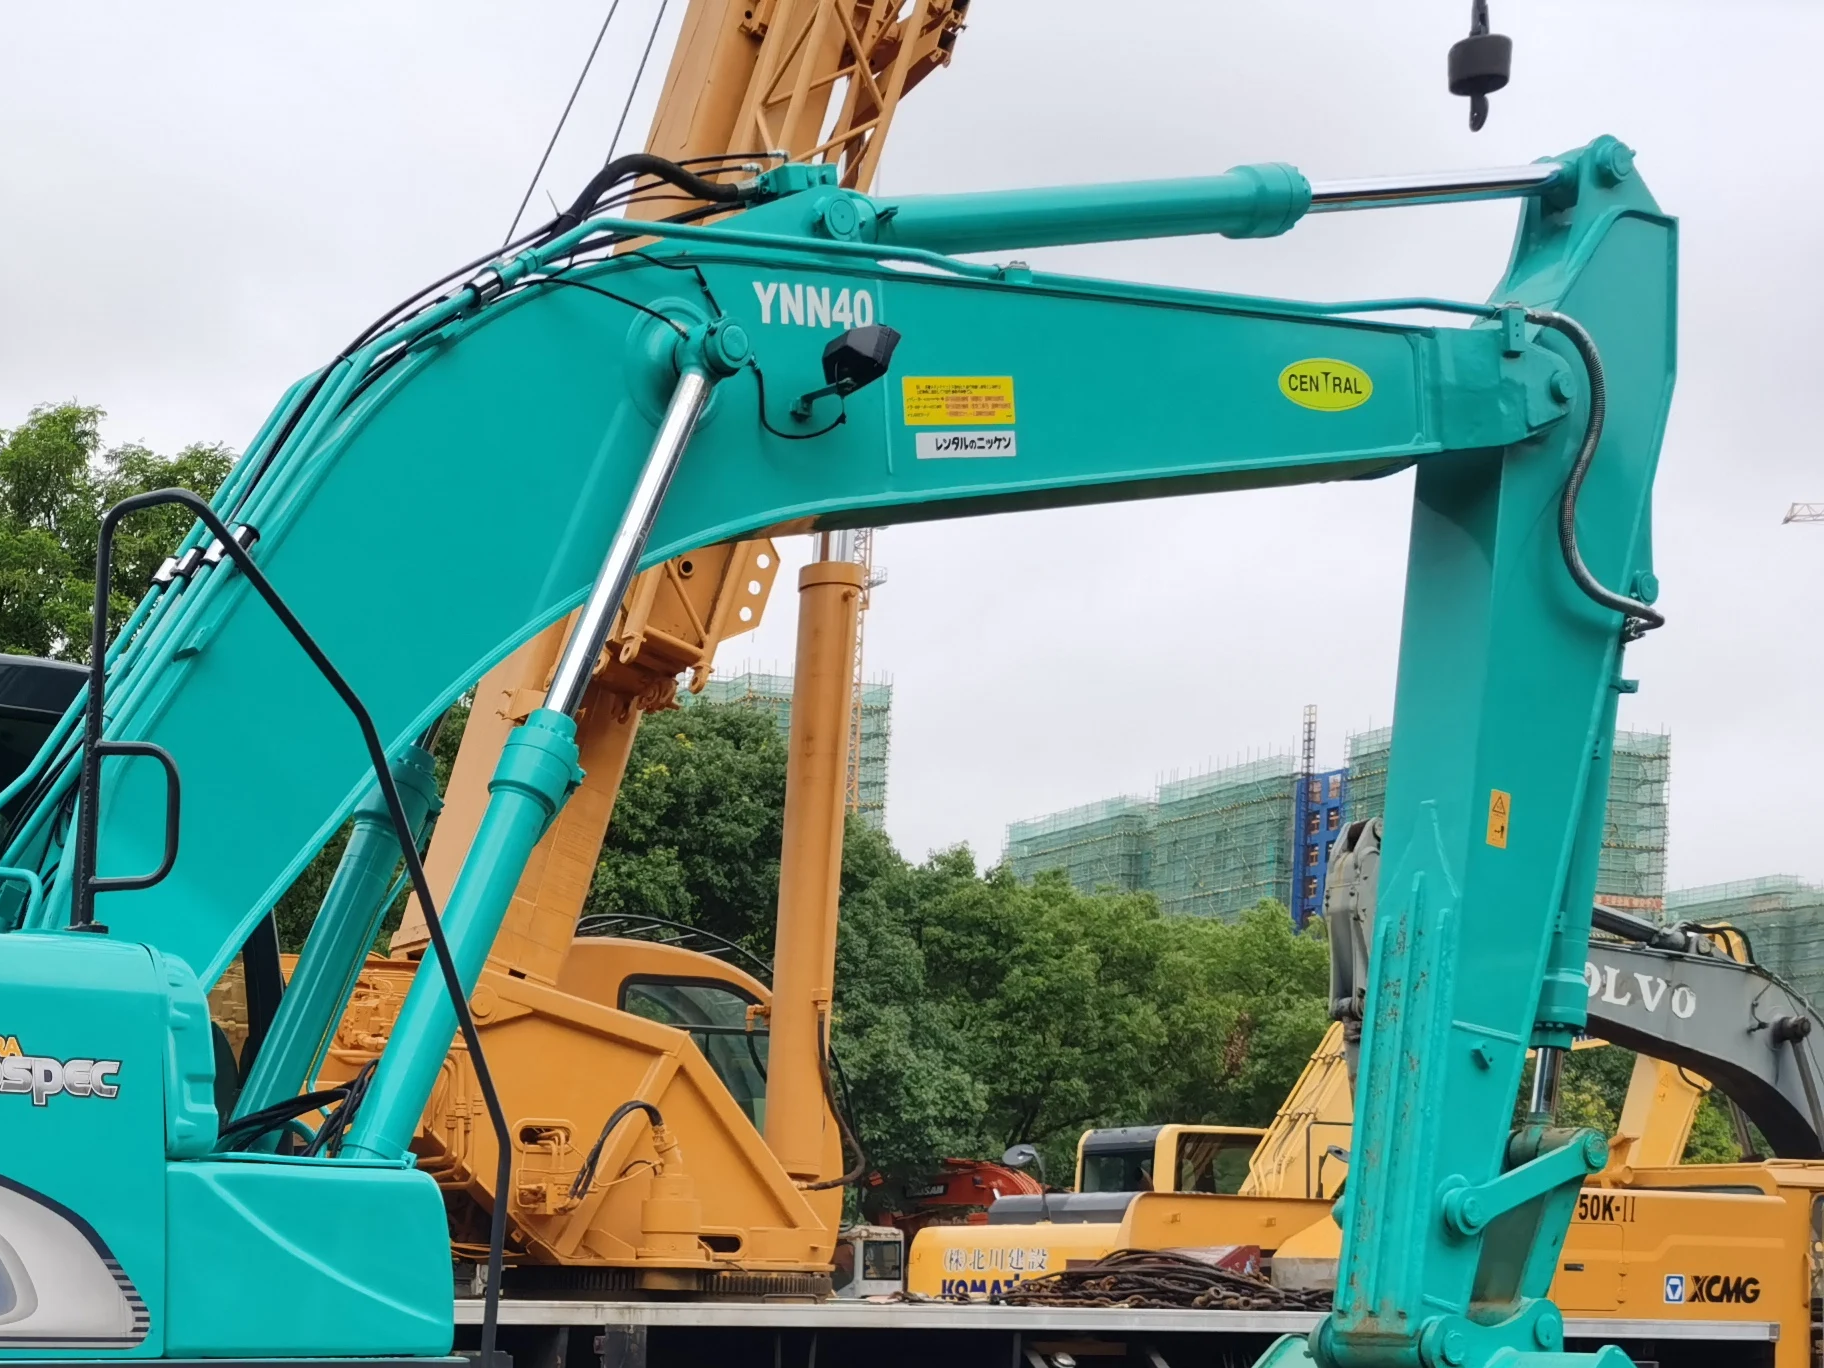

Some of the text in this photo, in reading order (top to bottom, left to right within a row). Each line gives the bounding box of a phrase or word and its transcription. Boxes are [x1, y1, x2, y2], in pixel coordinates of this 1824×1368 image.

[752, 281, 873, 330] YNN40
[1288, 371, 1363, 395] CENTRAL
[935, 436, 1011, 451] レンタルのニッケン
[941, 1273, 1022, 1300] KOMAT
[1686, 1275, 1761, 1304] XCMG
